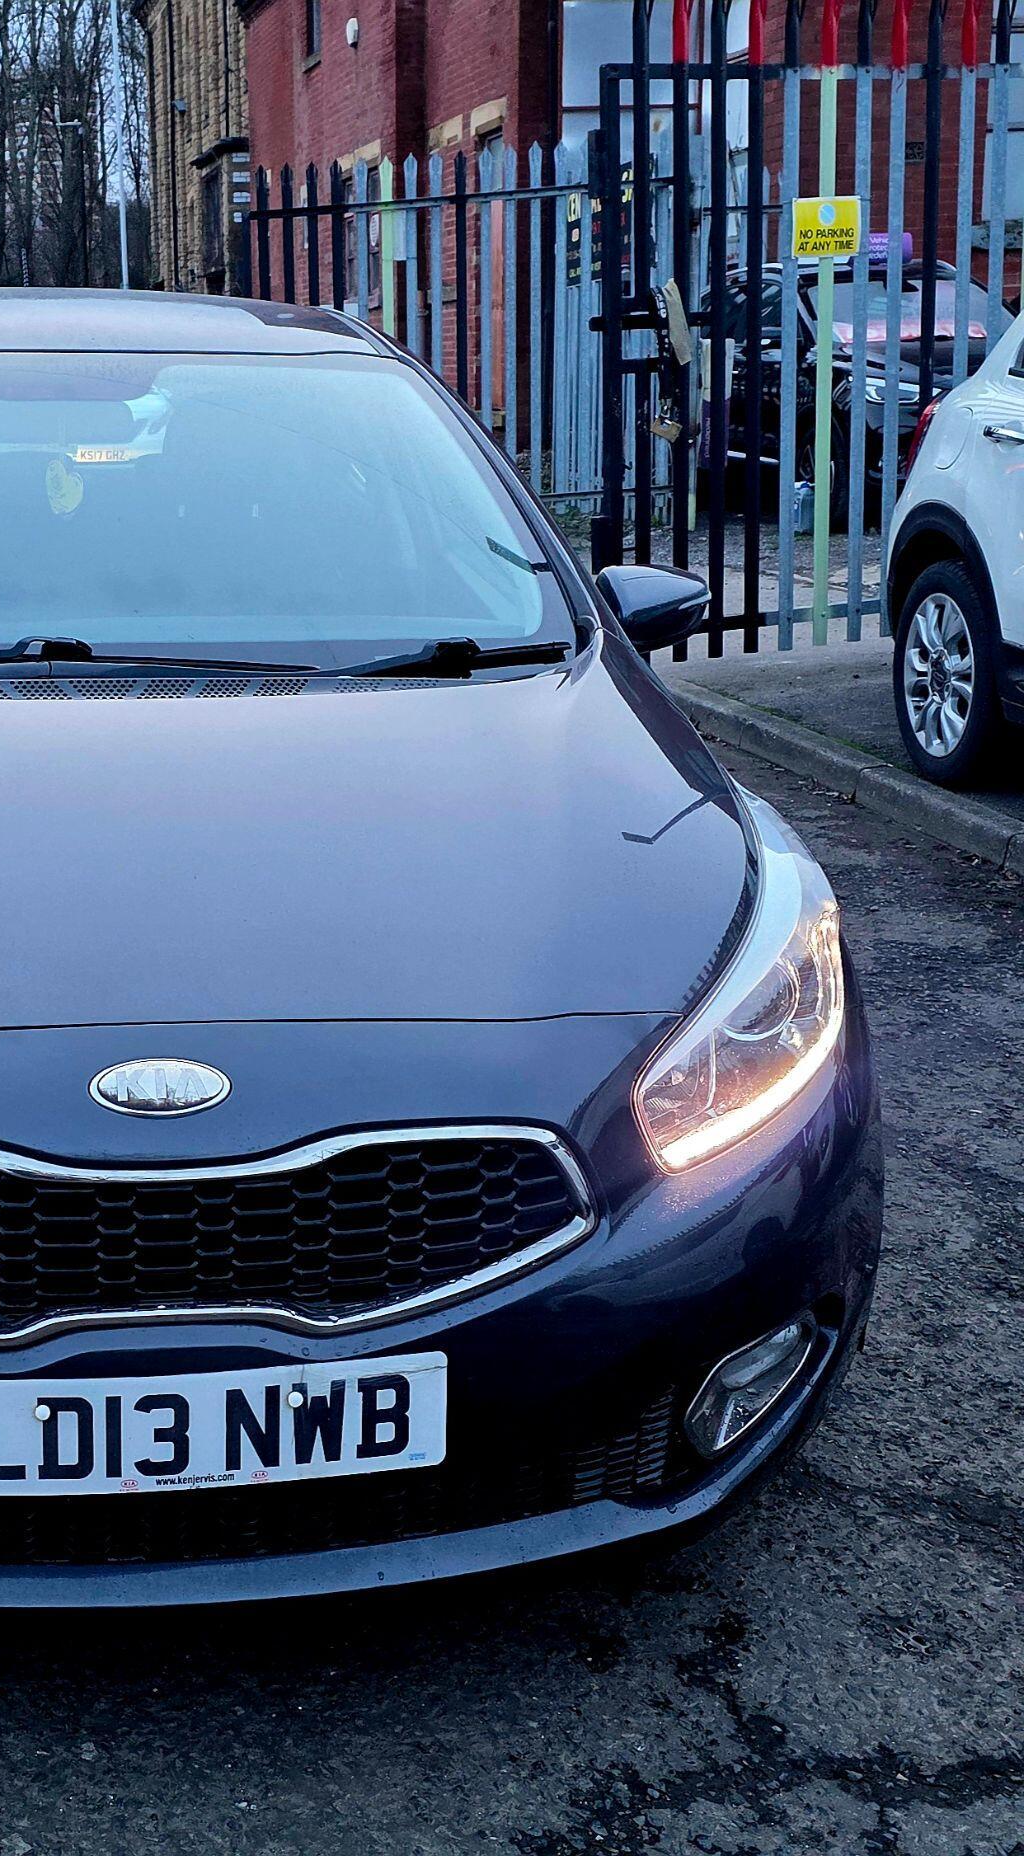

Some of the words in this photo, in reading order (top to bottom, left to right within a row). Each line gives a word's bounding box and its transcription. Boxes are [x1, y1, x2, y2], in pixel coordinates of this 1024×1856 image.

[799, 229, 813, 239] NO
[816, 228, 854, 239] PARKING
[798, 241, 811, 252] AT
[811, 241, 831, 251] ANY
[834, 240, 854, 250] TIME
[80, 450, 103, 460] KS17
[115, 1067, 210, 1102] KIA
[225, 1374, 411, 1472] NWB
[155, 1473, 235, 1487] www.kenjervis.com
